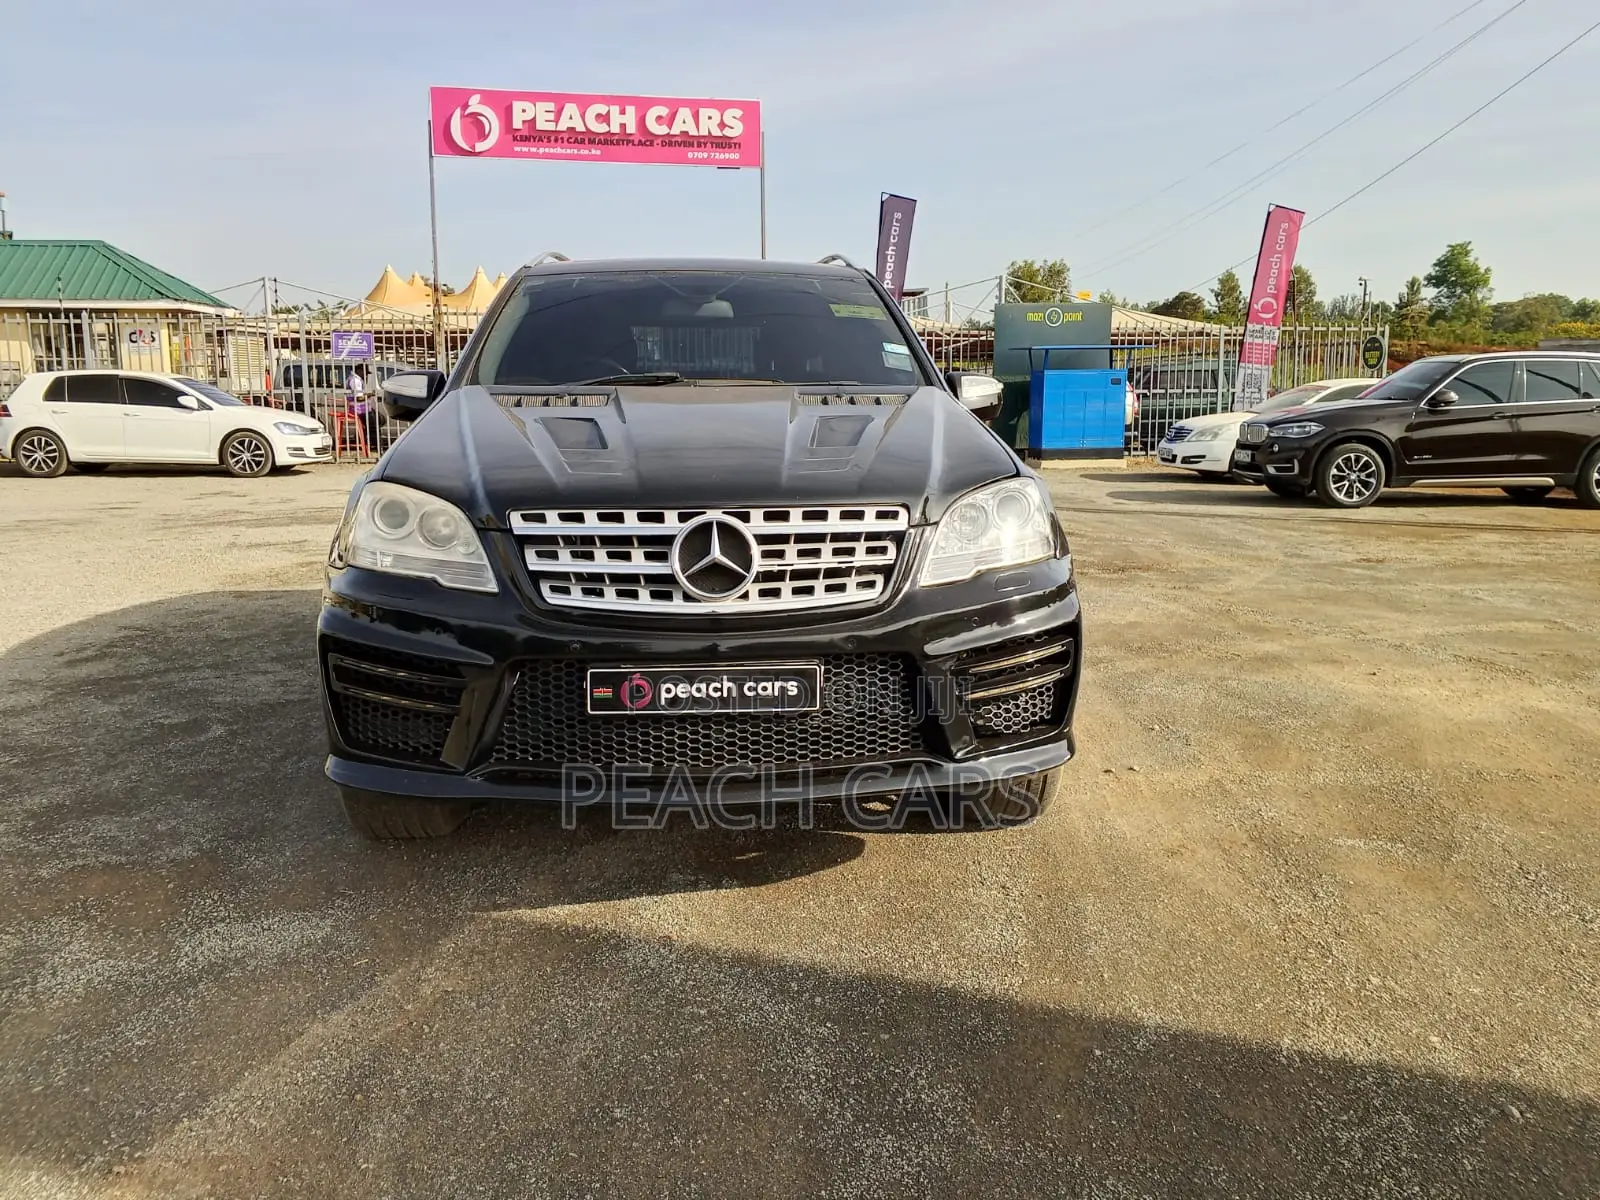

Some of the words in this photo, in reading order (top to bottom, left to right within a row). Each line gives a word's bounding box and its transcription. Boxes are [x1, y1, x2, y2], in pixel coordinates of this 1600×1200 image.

[511, 100, 636, 135] PEACH
[645, 105, 744, 138] CARS
[512, 134, 552, 144] KENYA'S
[566, 137, 586, 146] CAR
[587, 137, 655, 148] MARKETPLACE
[660, 140, 695, 149] DRIVEN
[696, 140, 709, 149] BY
[687, 151, 709, 159] 0709
[883, 245, 897, 289] peach
[890, 211, 902, 243] cars
[1266, 253, 1282, 295] peach
[1275, 222, 1289, 251] cars
[660, 675, 737, 706] peach
[743, 679, 798, 698] cars
